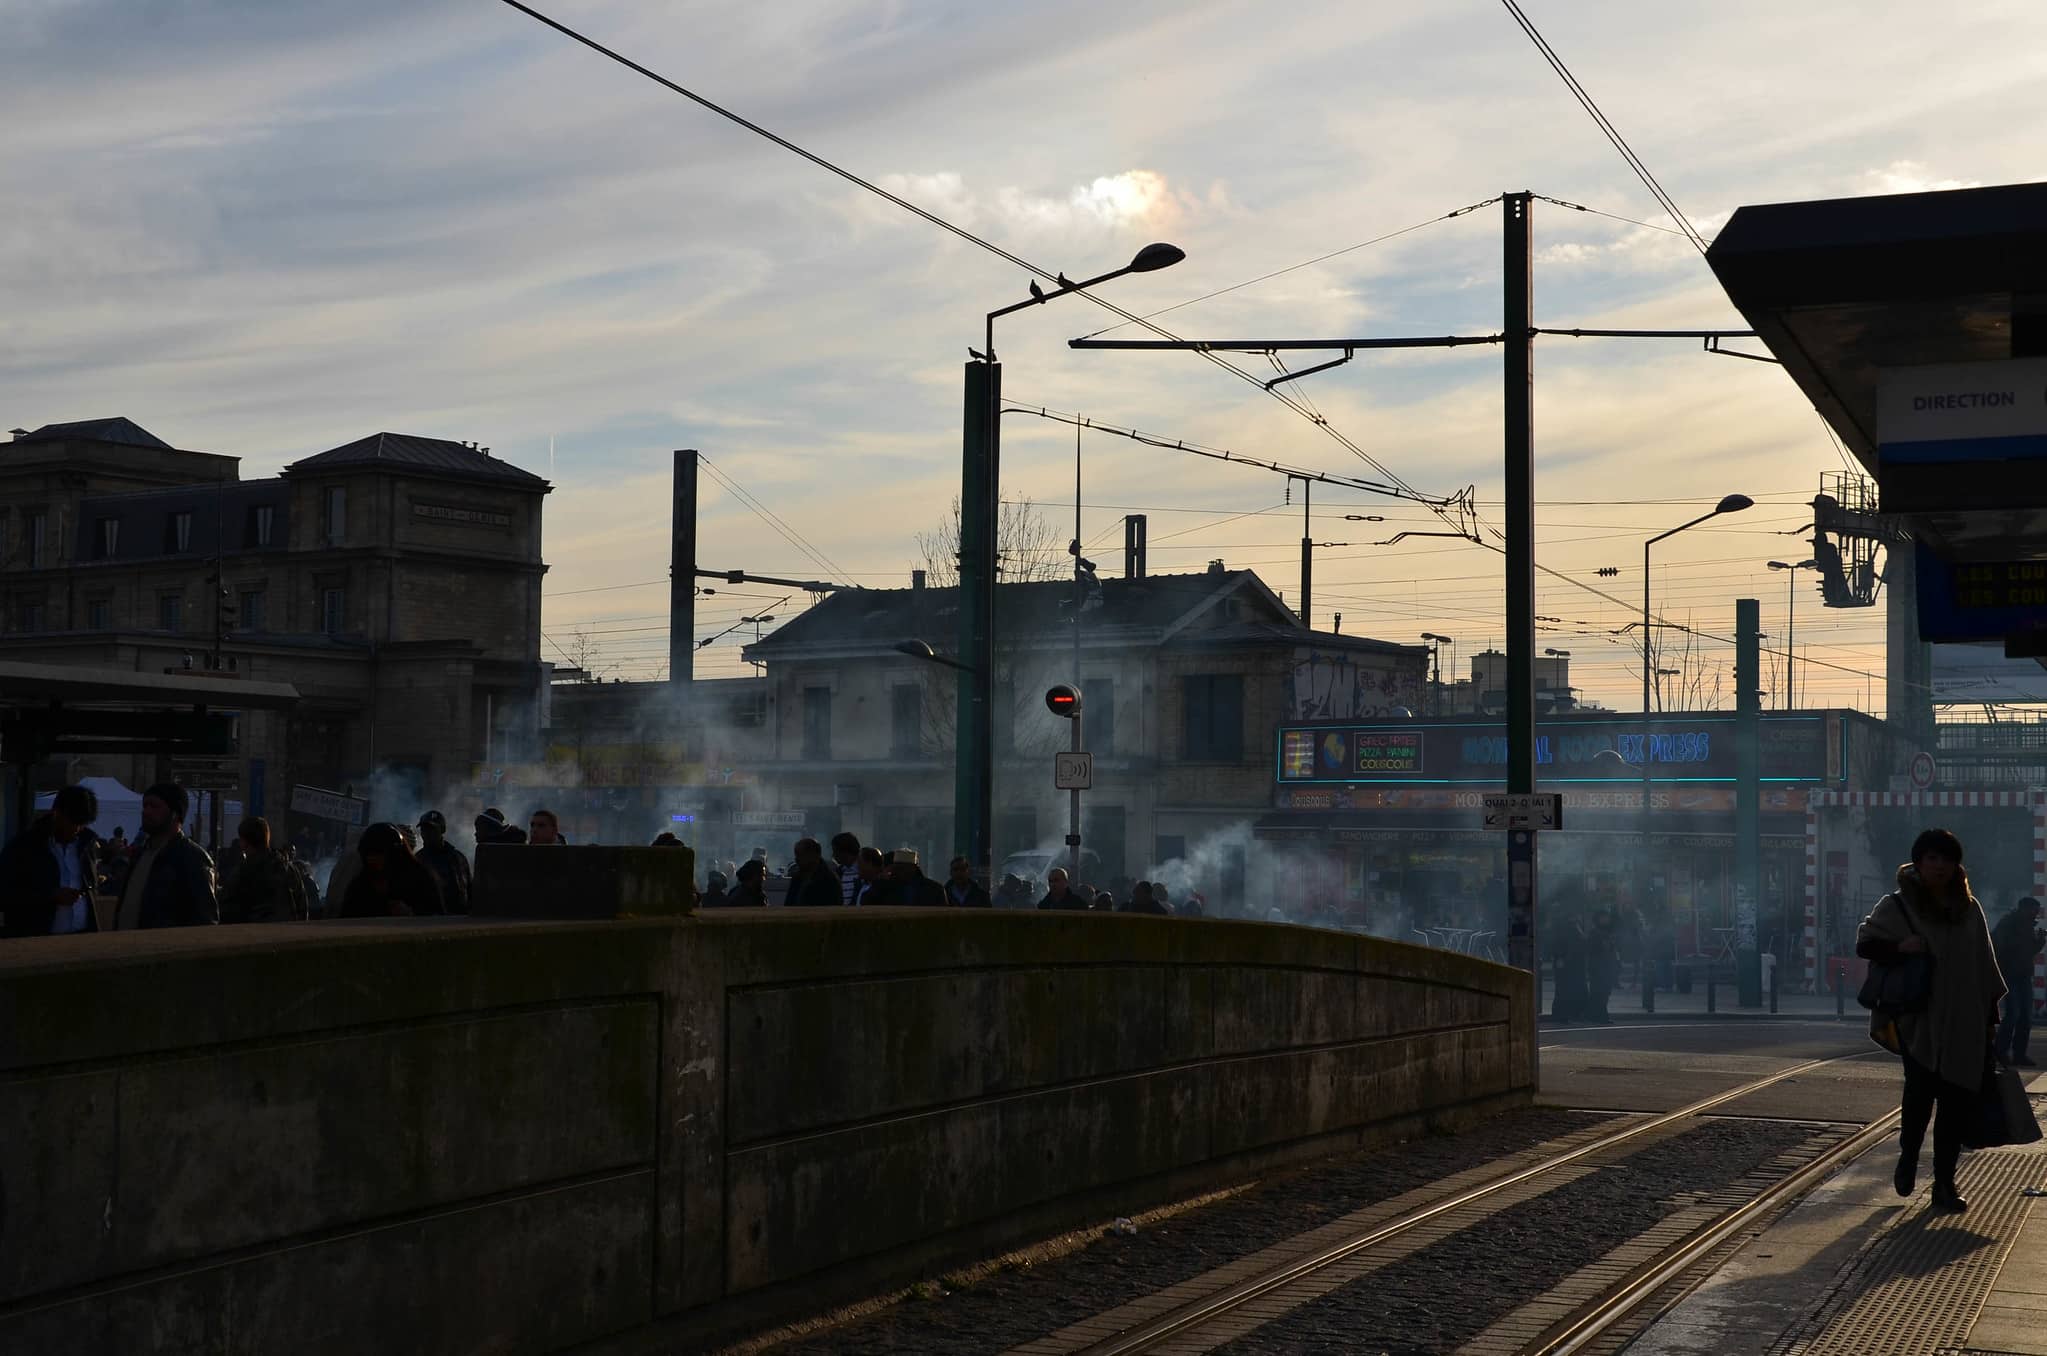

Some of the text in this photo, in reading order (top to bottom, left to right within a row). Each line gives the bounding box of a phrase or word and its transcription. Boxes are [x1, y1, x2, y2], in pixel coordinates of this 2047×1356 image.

[1913, 391, 2016, 411] DIRECTION
[1360, 759, 1415, 770] COUSCOUS
[1485, 798, 1508, 809] QUAI
